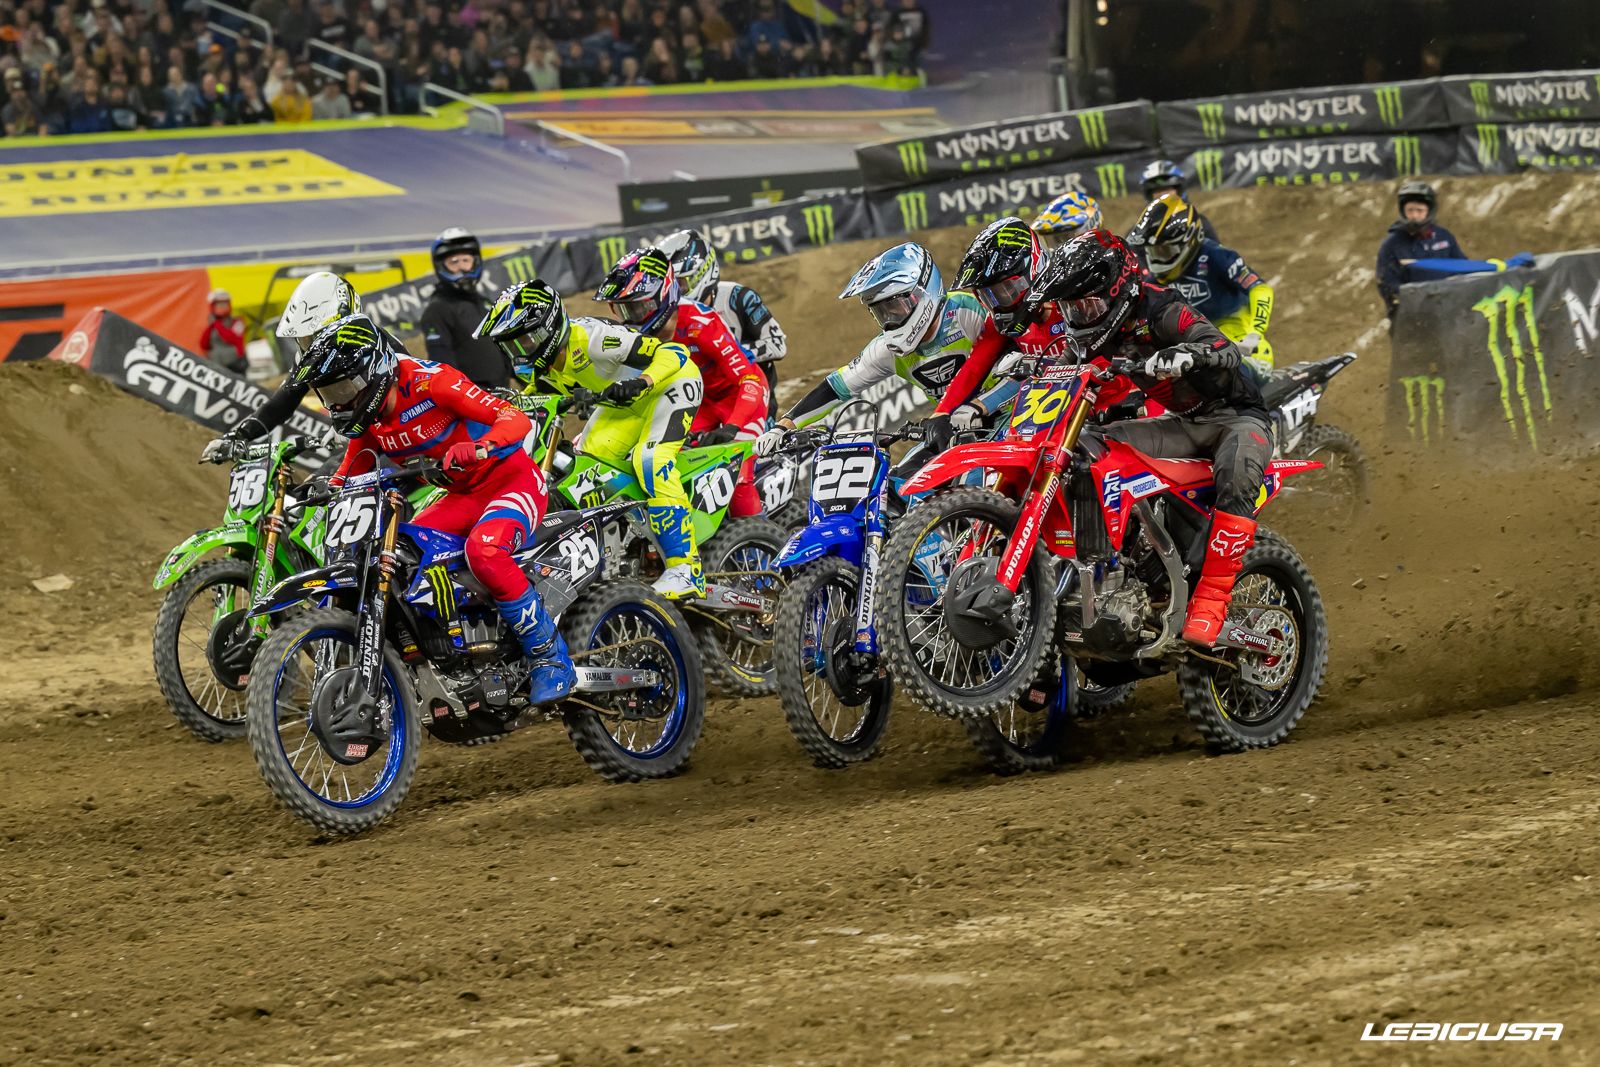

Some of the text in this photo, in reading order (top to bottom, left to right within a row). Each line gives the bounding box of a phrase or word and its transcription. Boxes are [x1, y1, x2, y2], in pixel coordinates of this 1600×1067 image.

[1235, 95, 1366, 126] MONSTER
[936, 120, 1071, 160] MONSTER
[961, 148, 1054, 172] ENERGY
[1235, 142, 1380, 173] MONSTER
[1110, 249, 1132, 297] OAKLEY
[160, 345, 232, 393] ROCKY
[407, 400, 436, 420] YAMAHA
[664, 380, 702, 405] FOX
[926, 387, 948, 396] CLU
[1012, 389, 1071, 428] 30
[229, 469, 267, 509] 53
[576, 463, 601, 489] KX
[695, 467, 736, 515] 10
[763, 467, 795, 512] 82
[813, 456, 876, 500] 22
[1104, 469, 1120, 507] CRF
[325, 496, 376, 547] 25
[541, 518, 563, 528] YAMAHA
[559, 529, 600, 582] 25
[1005, 516, 1034, 580] DUNLOP
[861, 566, 873, 625] DUNLOP
[363, 615, 374, 677] DUNLOP
